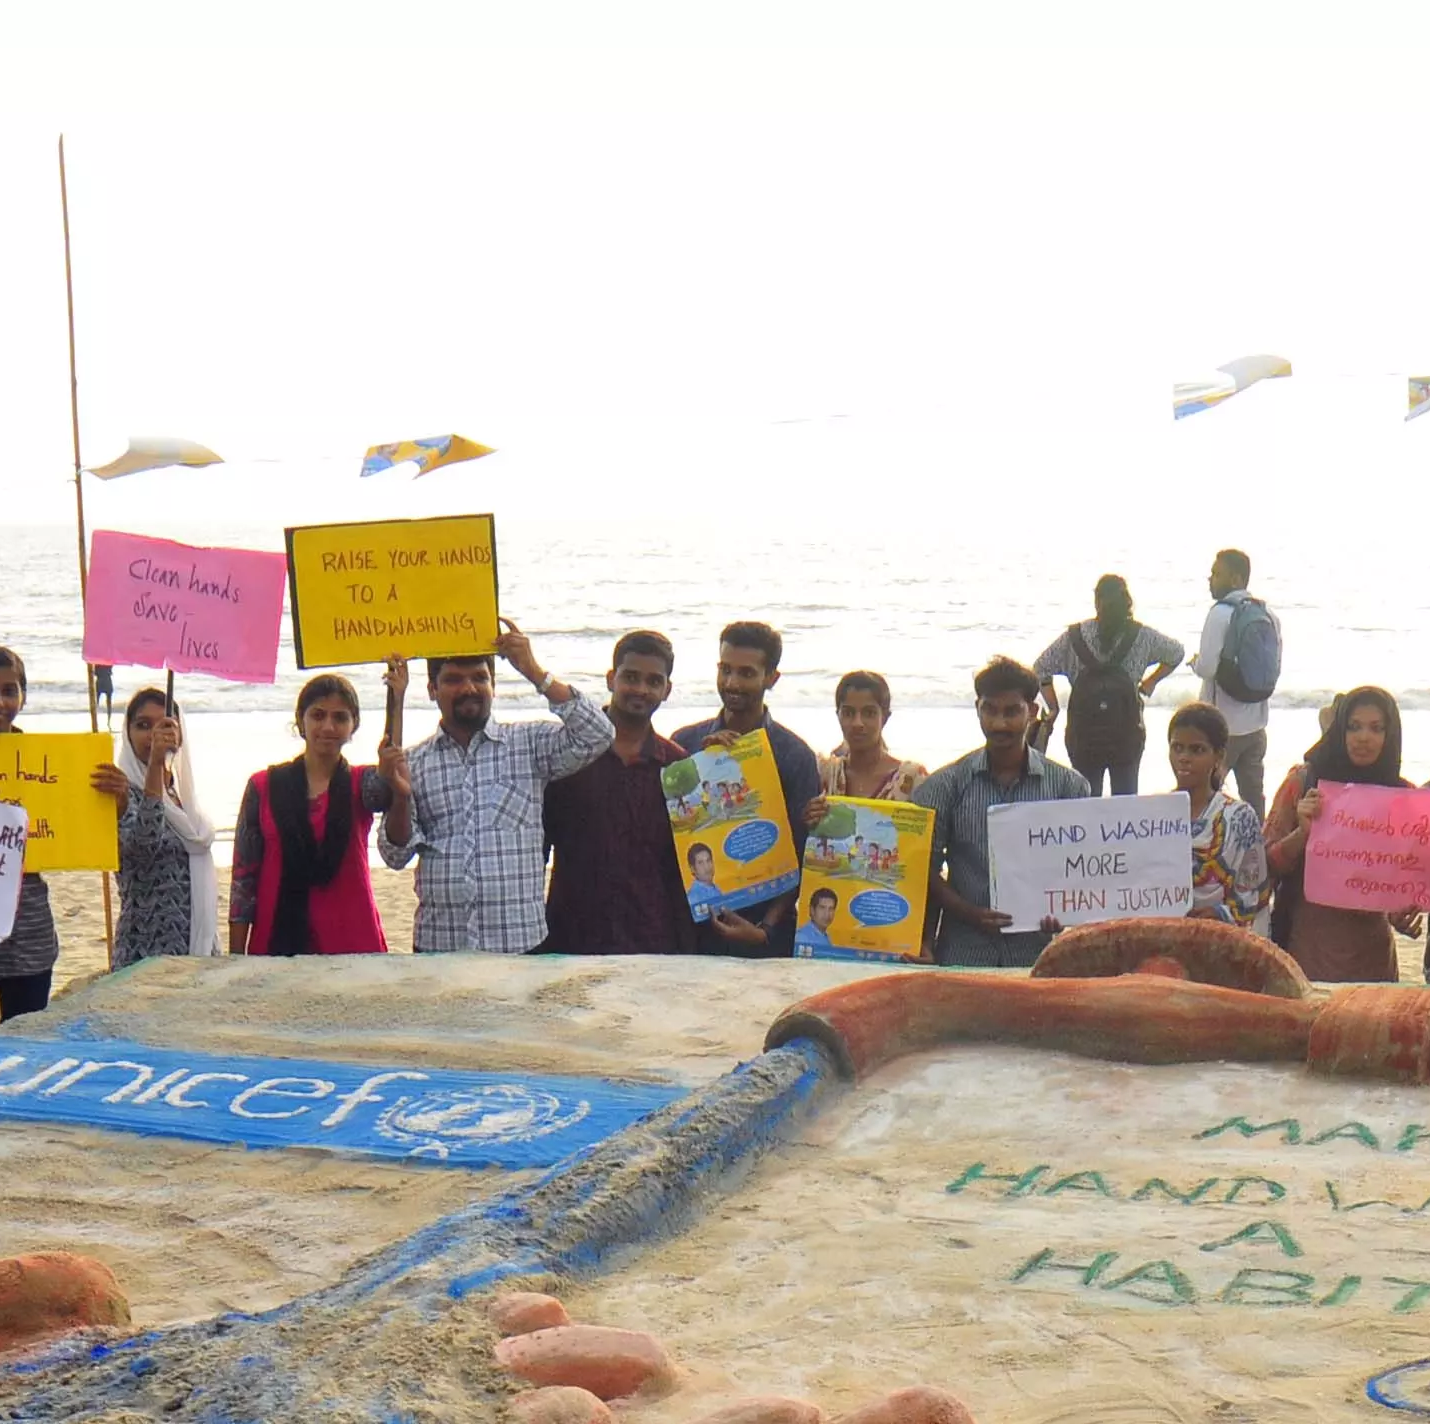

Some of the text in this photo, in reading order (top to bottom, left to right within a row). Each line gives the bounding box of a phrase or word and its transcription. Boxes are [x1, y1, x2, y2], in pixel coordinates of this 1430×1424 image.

[322, 545, 491, 573] RAISE YOUR HANDS
[128, 558, 241, 604] Clean hands
[346, 583, 399, 604] TO A
[334, 612, 477, 642] HANDWASHING
[15, 749, 59, 785] hands
[1027, 817, 1189, 847] HAND WASHING
[1065, 852, 1129, 878] MORE
[1044, 888, 1106, 915] THAN
[1116, 886, 1160, 912] JUST
[1199, 1219, 1304, 1259] A
